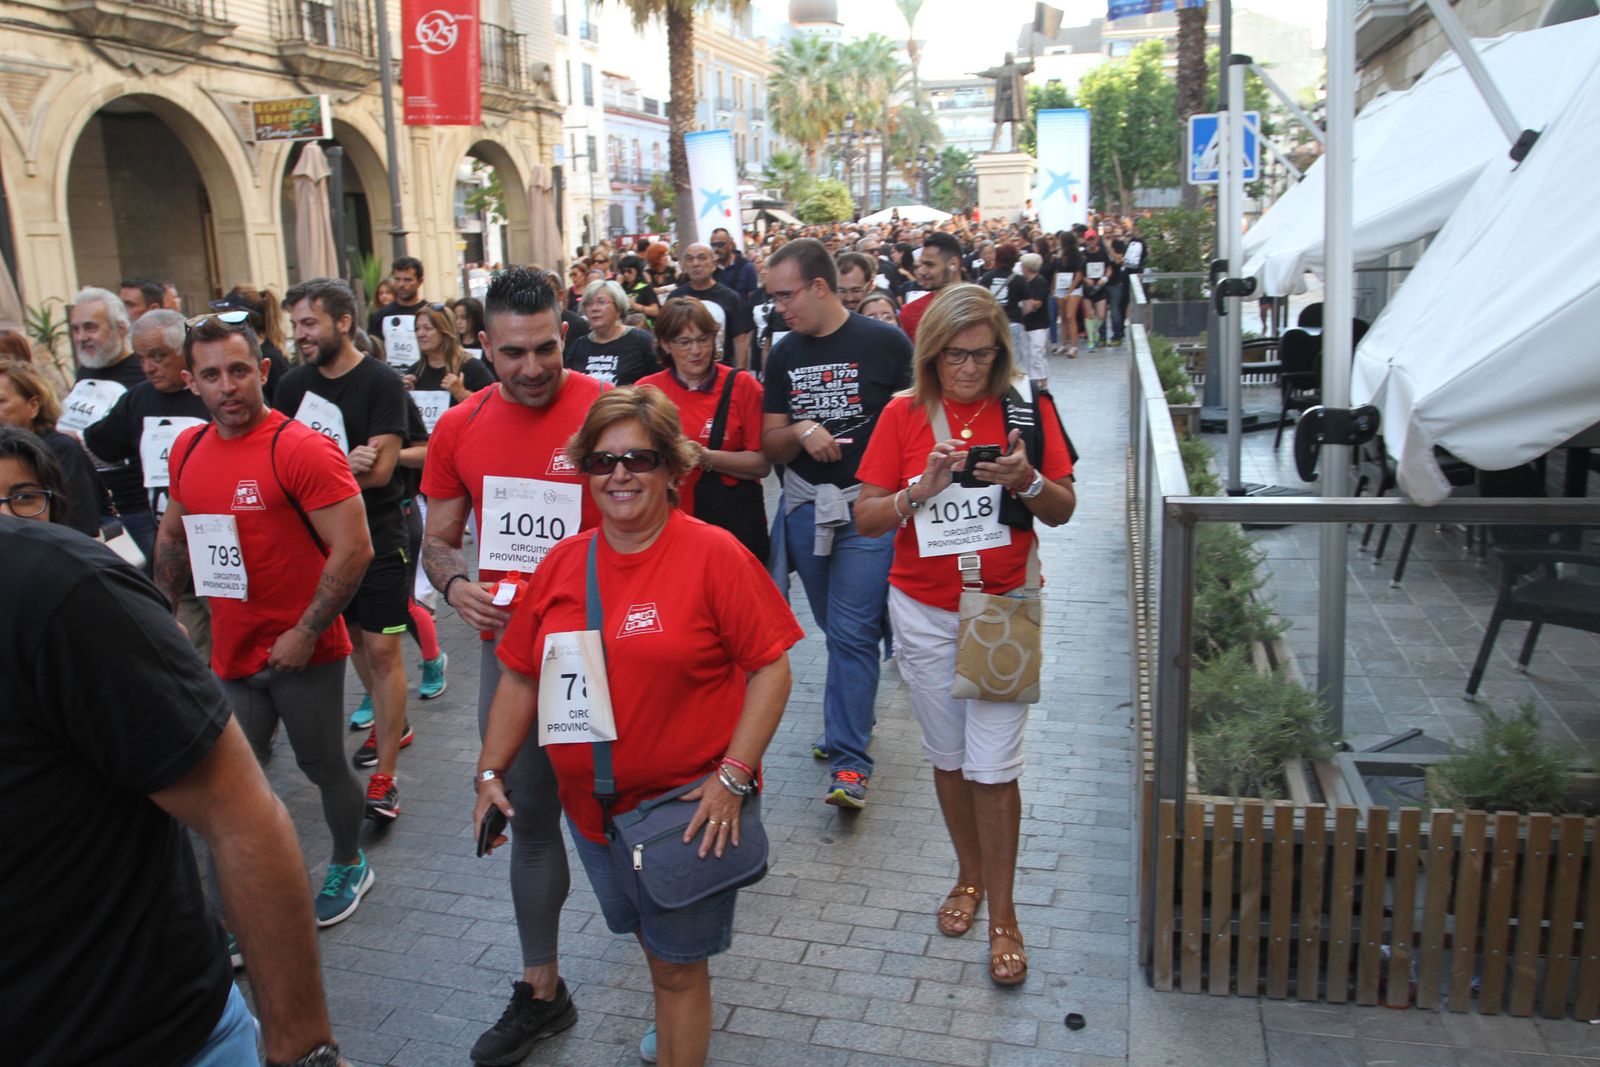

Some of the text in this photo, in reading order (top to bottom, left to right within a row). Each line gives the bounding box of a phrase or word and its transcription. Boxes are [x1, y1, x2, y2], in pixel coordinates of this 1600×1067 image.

[833, 369, 858, 379] 1970
[815, 395, 848, 408] 1853
[70, 401, 95, 416] 444
[929, 496, 993, 523] 1018
[499, 512, 565, 540] 1010
[943, 525, 983, 537] CIRCUITOS
[927, 534, 981, 548] PROVINCIALES
[208, 545, 241, 567] 793
[213, 572, 241, 580] CIRCUITOS
[203, 581, 239, 590] PROVINCIALES
